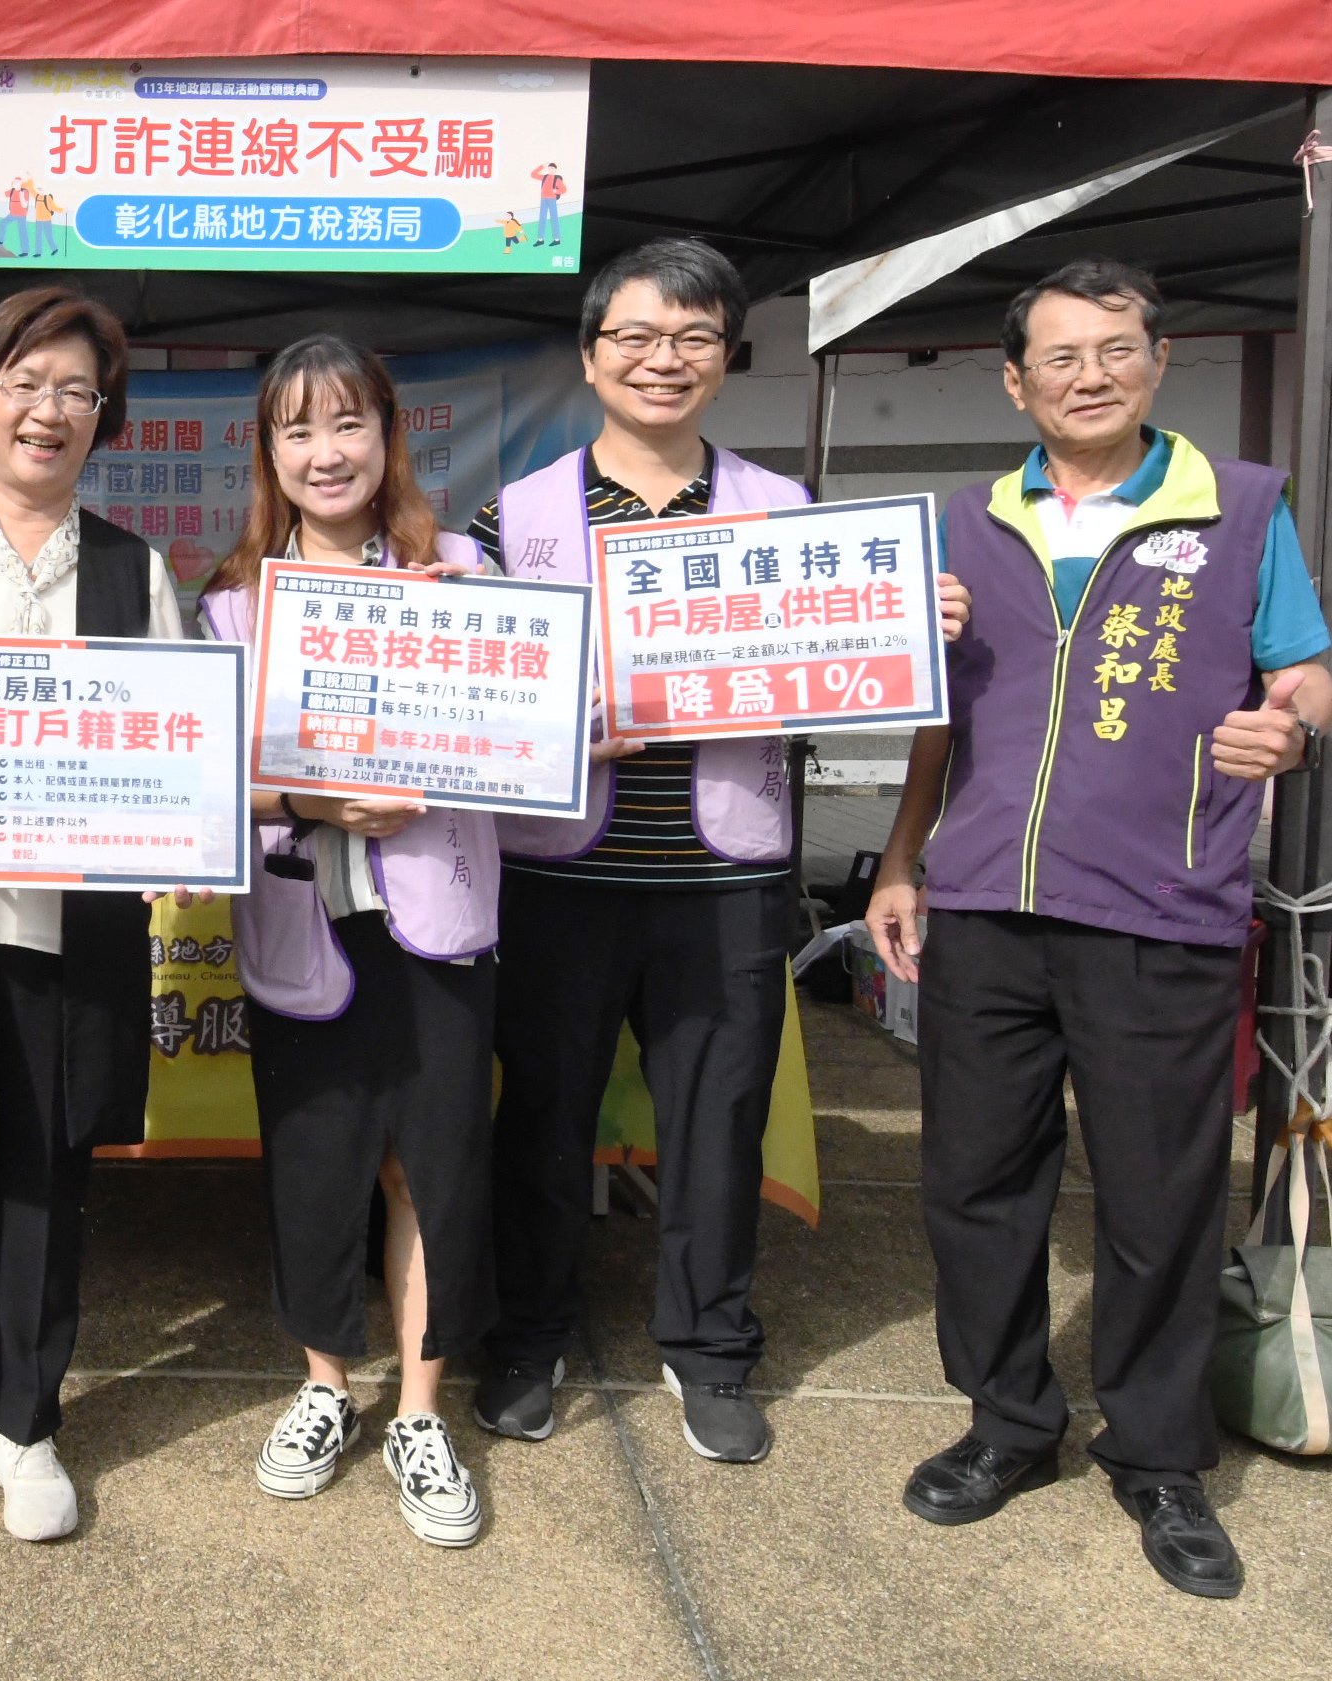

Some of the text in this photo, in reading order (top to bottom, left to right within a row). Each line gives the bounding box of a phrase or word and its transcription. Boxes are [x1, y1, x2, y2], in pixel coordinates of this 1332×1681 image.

[49, 115, 495, 180] 打詐連線不受騙
[114, 203, 422, 243] 彰化縣地方稅務局
[625, 537, 901, 596] 全國僅持有
[303, 600, 550, 637] 房屋稅由按月課徵
[1148, 575, 1194, 692] 地政處長
[381, 679, 538, 704] 上一年7/1-當年6/30
[1093, 604, 1150, 742] 蔡和昌
[381, 700, 485, 723] 每年5/1-5/31
[379, 728, 535, 760] 每年2月最後一天
[352, 756, 478, 778] 如有變更房屋使用情形
[12, 816, 88, 827] 除上述要件以外
